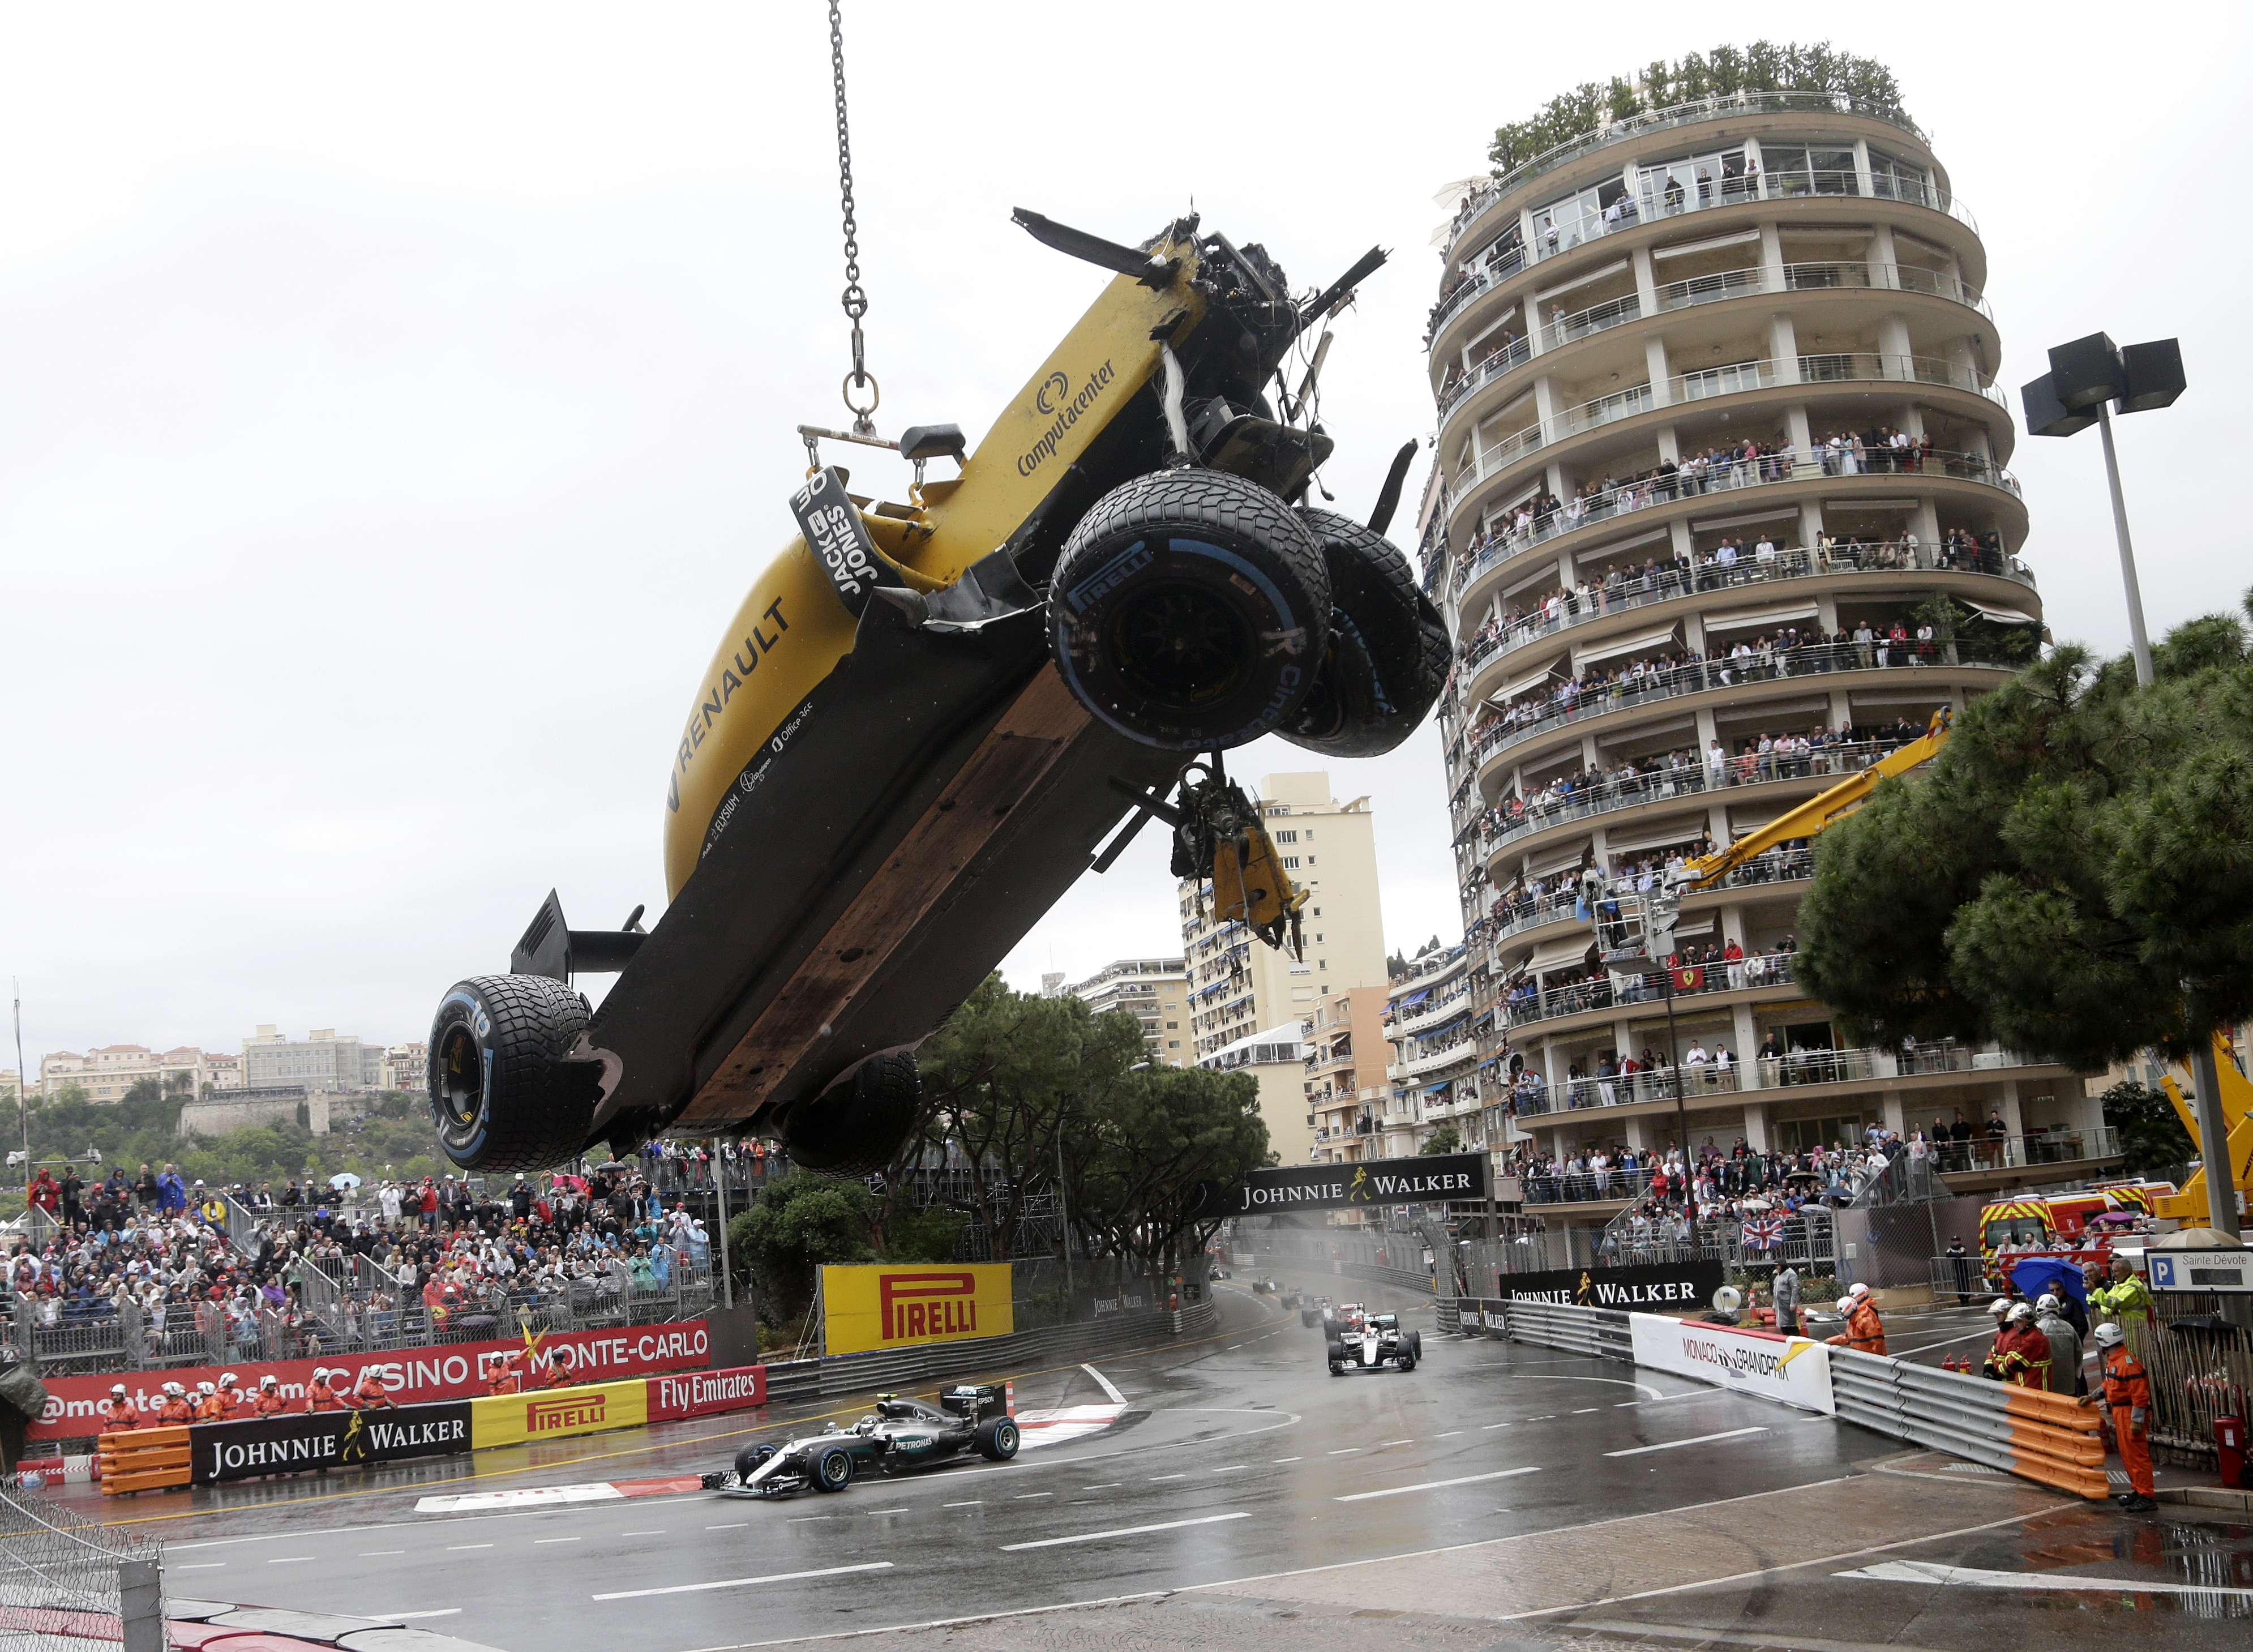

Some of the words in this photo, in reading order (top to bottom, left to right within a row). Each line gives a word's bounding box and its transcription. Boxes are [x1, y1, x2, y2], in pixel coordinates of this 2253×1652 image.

[1017, 358, 1115, 477] Computacenter
[796, 472, 827, 513] 30
[818, 531, 861, 595] JACK
[1067, 540, 1154, 616] PIRELLI
[678, 596, 790, 773] RENAULT
[781, 717, 801, 742] Office
[715, 793, 740, 833] ELYSIUM
[1241, 1183, 1343, 1210] JOHNNIE
[1373, 1173, 1470, 1195] WALKER
[2182, 1255, 2211, 1265] Sainte
[2214, 1254, 2247, 1265] Dévote
[880, 1272, 977, 1340] PIRELLI
[1094, 1298, 1118, 1317] JOHNNIE
[1122, 1294, 1143, 1308] WALKER
[1596, 1282, 1695, 1304] WALKER
[1459, 1308, 1480, 1329] JOHNNIE
[1483, 1310, 1505, 1329] WALKER
[1682, 1337, 1717, 1364] MONACO
[325, 1355, 469, 1397] CASINO
[660, 1378, 689, 1412] Fly
[692, 1372, 755, 1405] Emirates
[526, 1394, 605, 1432] PIRELLI
[978, 1396, 995, 1405] EPSON
[209, 1435, 336, 1478] JOHNNIE
[369, 1419, 465, 1450] WALKER
[896, 1437, 932, 1450] PETRONAS
